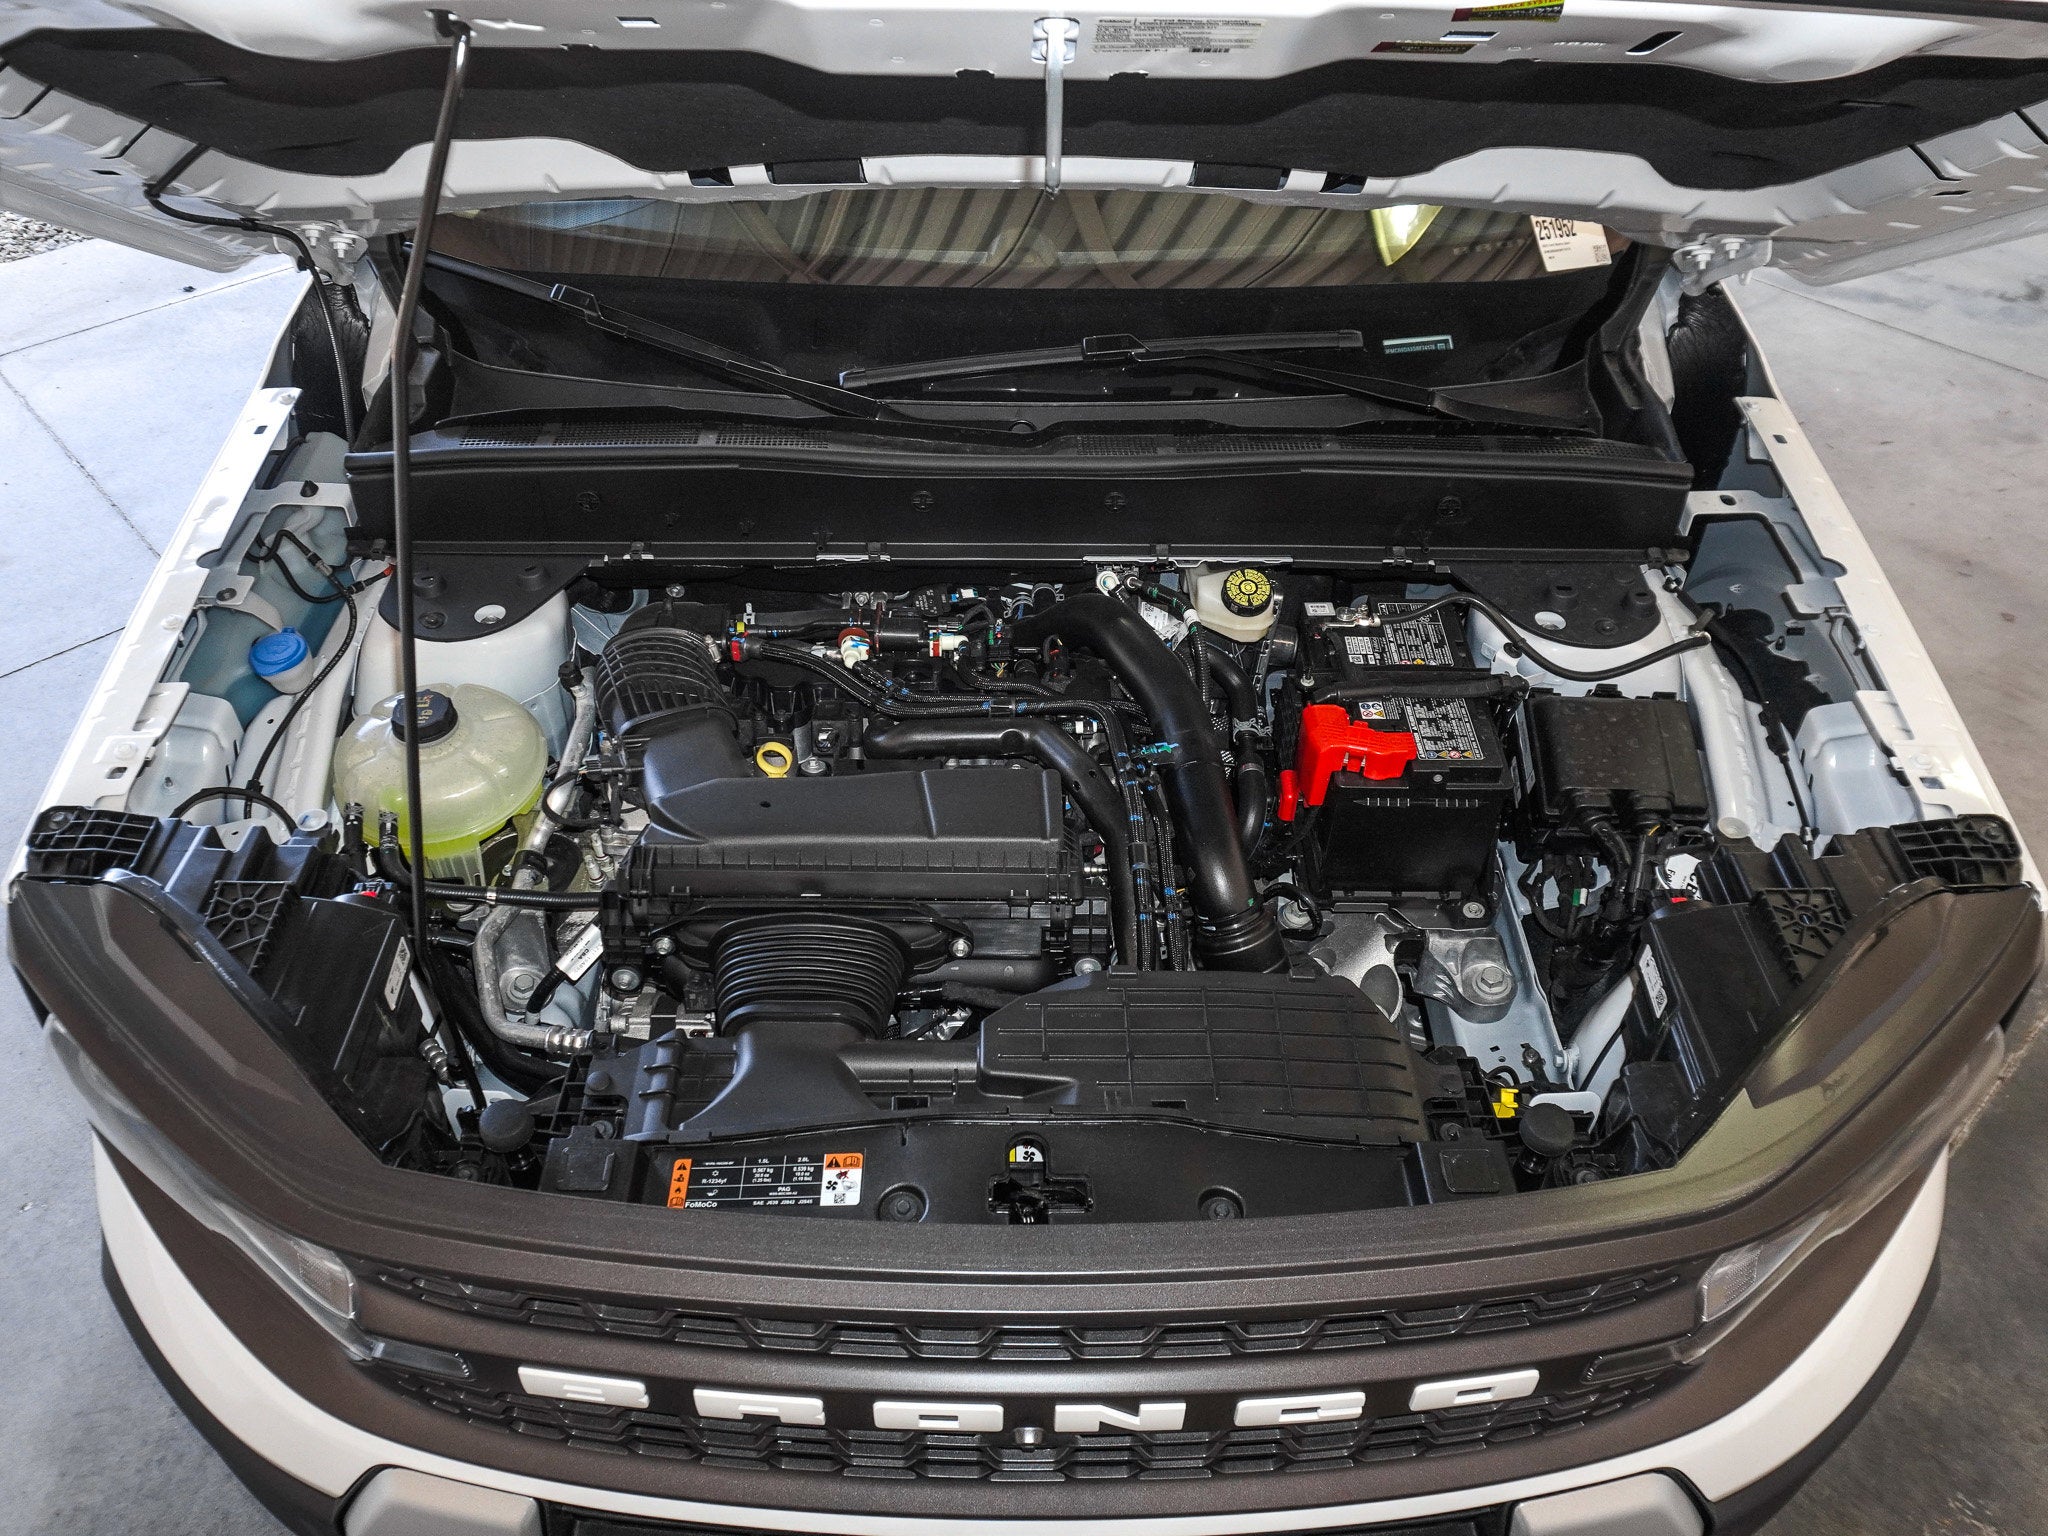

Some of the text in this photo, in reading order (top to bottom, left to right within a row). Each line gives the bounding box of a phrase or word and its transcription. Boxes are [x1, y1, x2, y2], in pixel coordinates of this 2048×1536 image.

[1535, 218, 1577, 240] 251952
[684, 1200, 718, 1208] FoMoCo
[517, 1366, 1541, 1434] BRONCO
